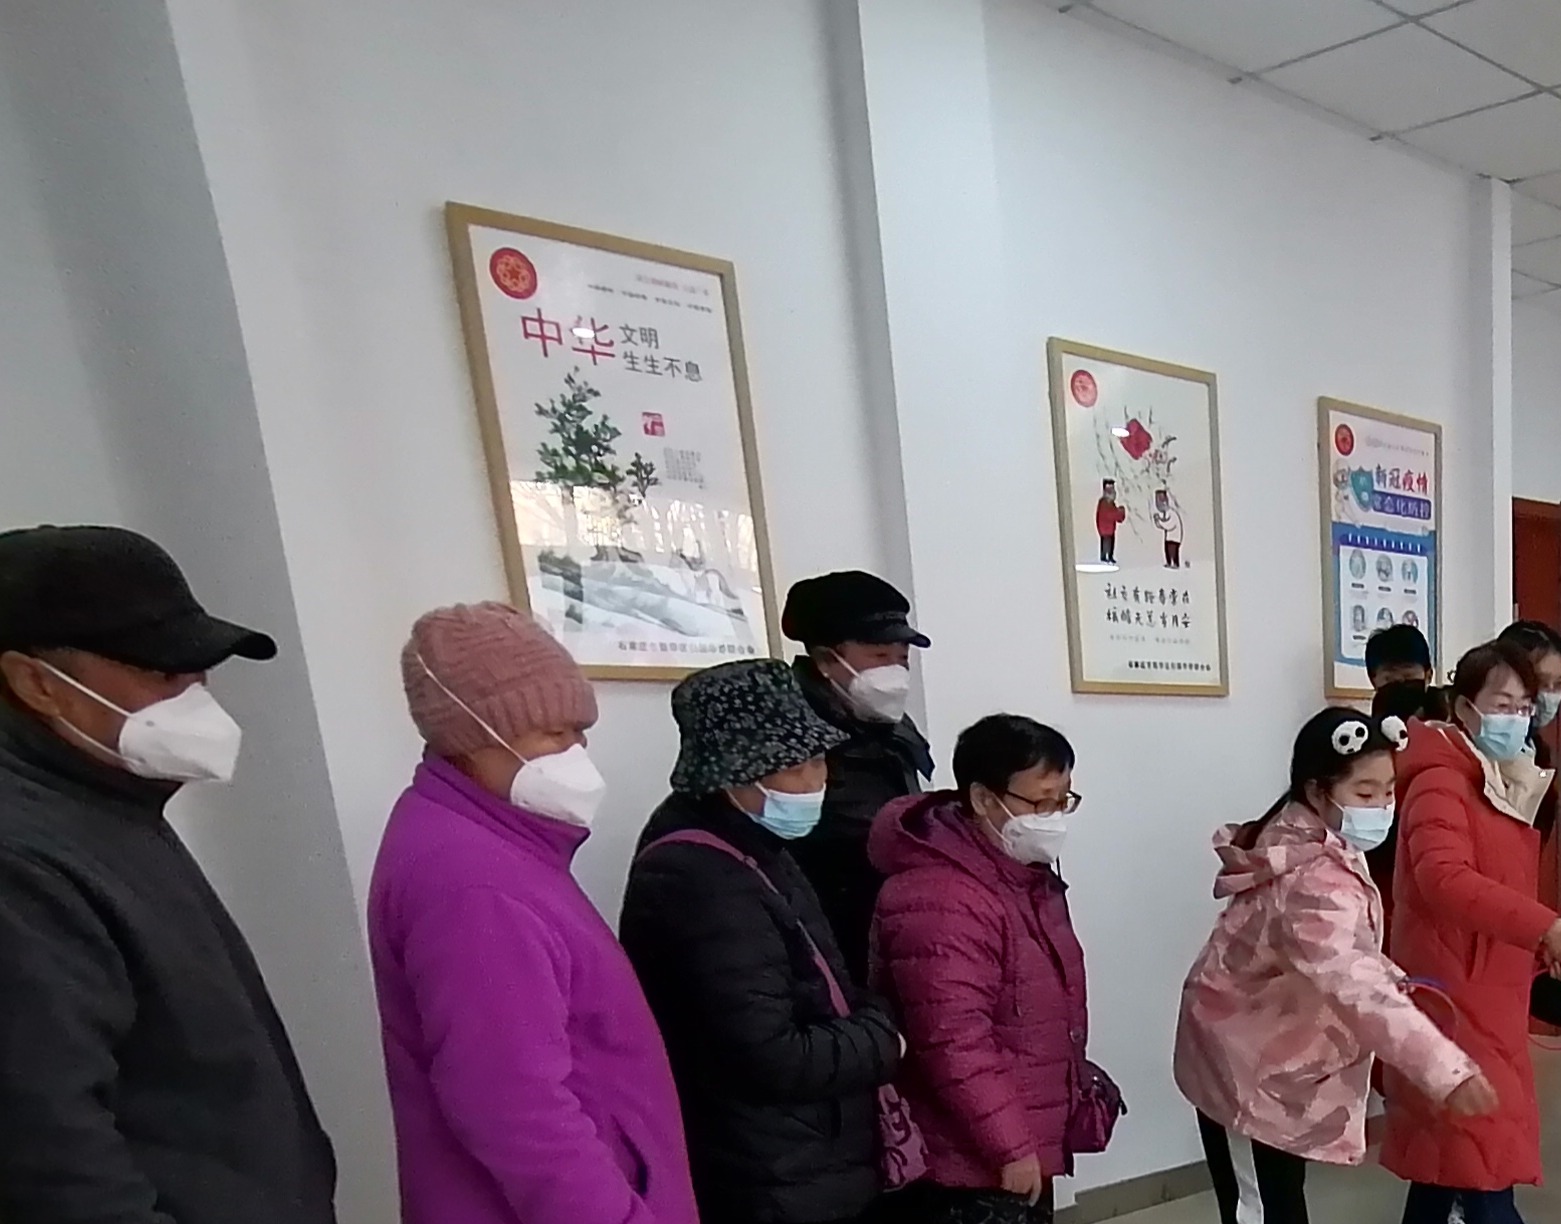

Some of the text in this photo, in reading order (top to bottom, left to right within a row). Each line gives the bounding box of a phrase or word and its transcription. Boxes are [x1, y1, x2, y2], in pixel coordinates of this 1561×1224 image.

[520, 308, 616, 366] 中华
[619, 323, 660, 350] 文明
[623, 351, 703, 383] 生生不息
[1375, 463, 1429, 495] 新冠疫情
